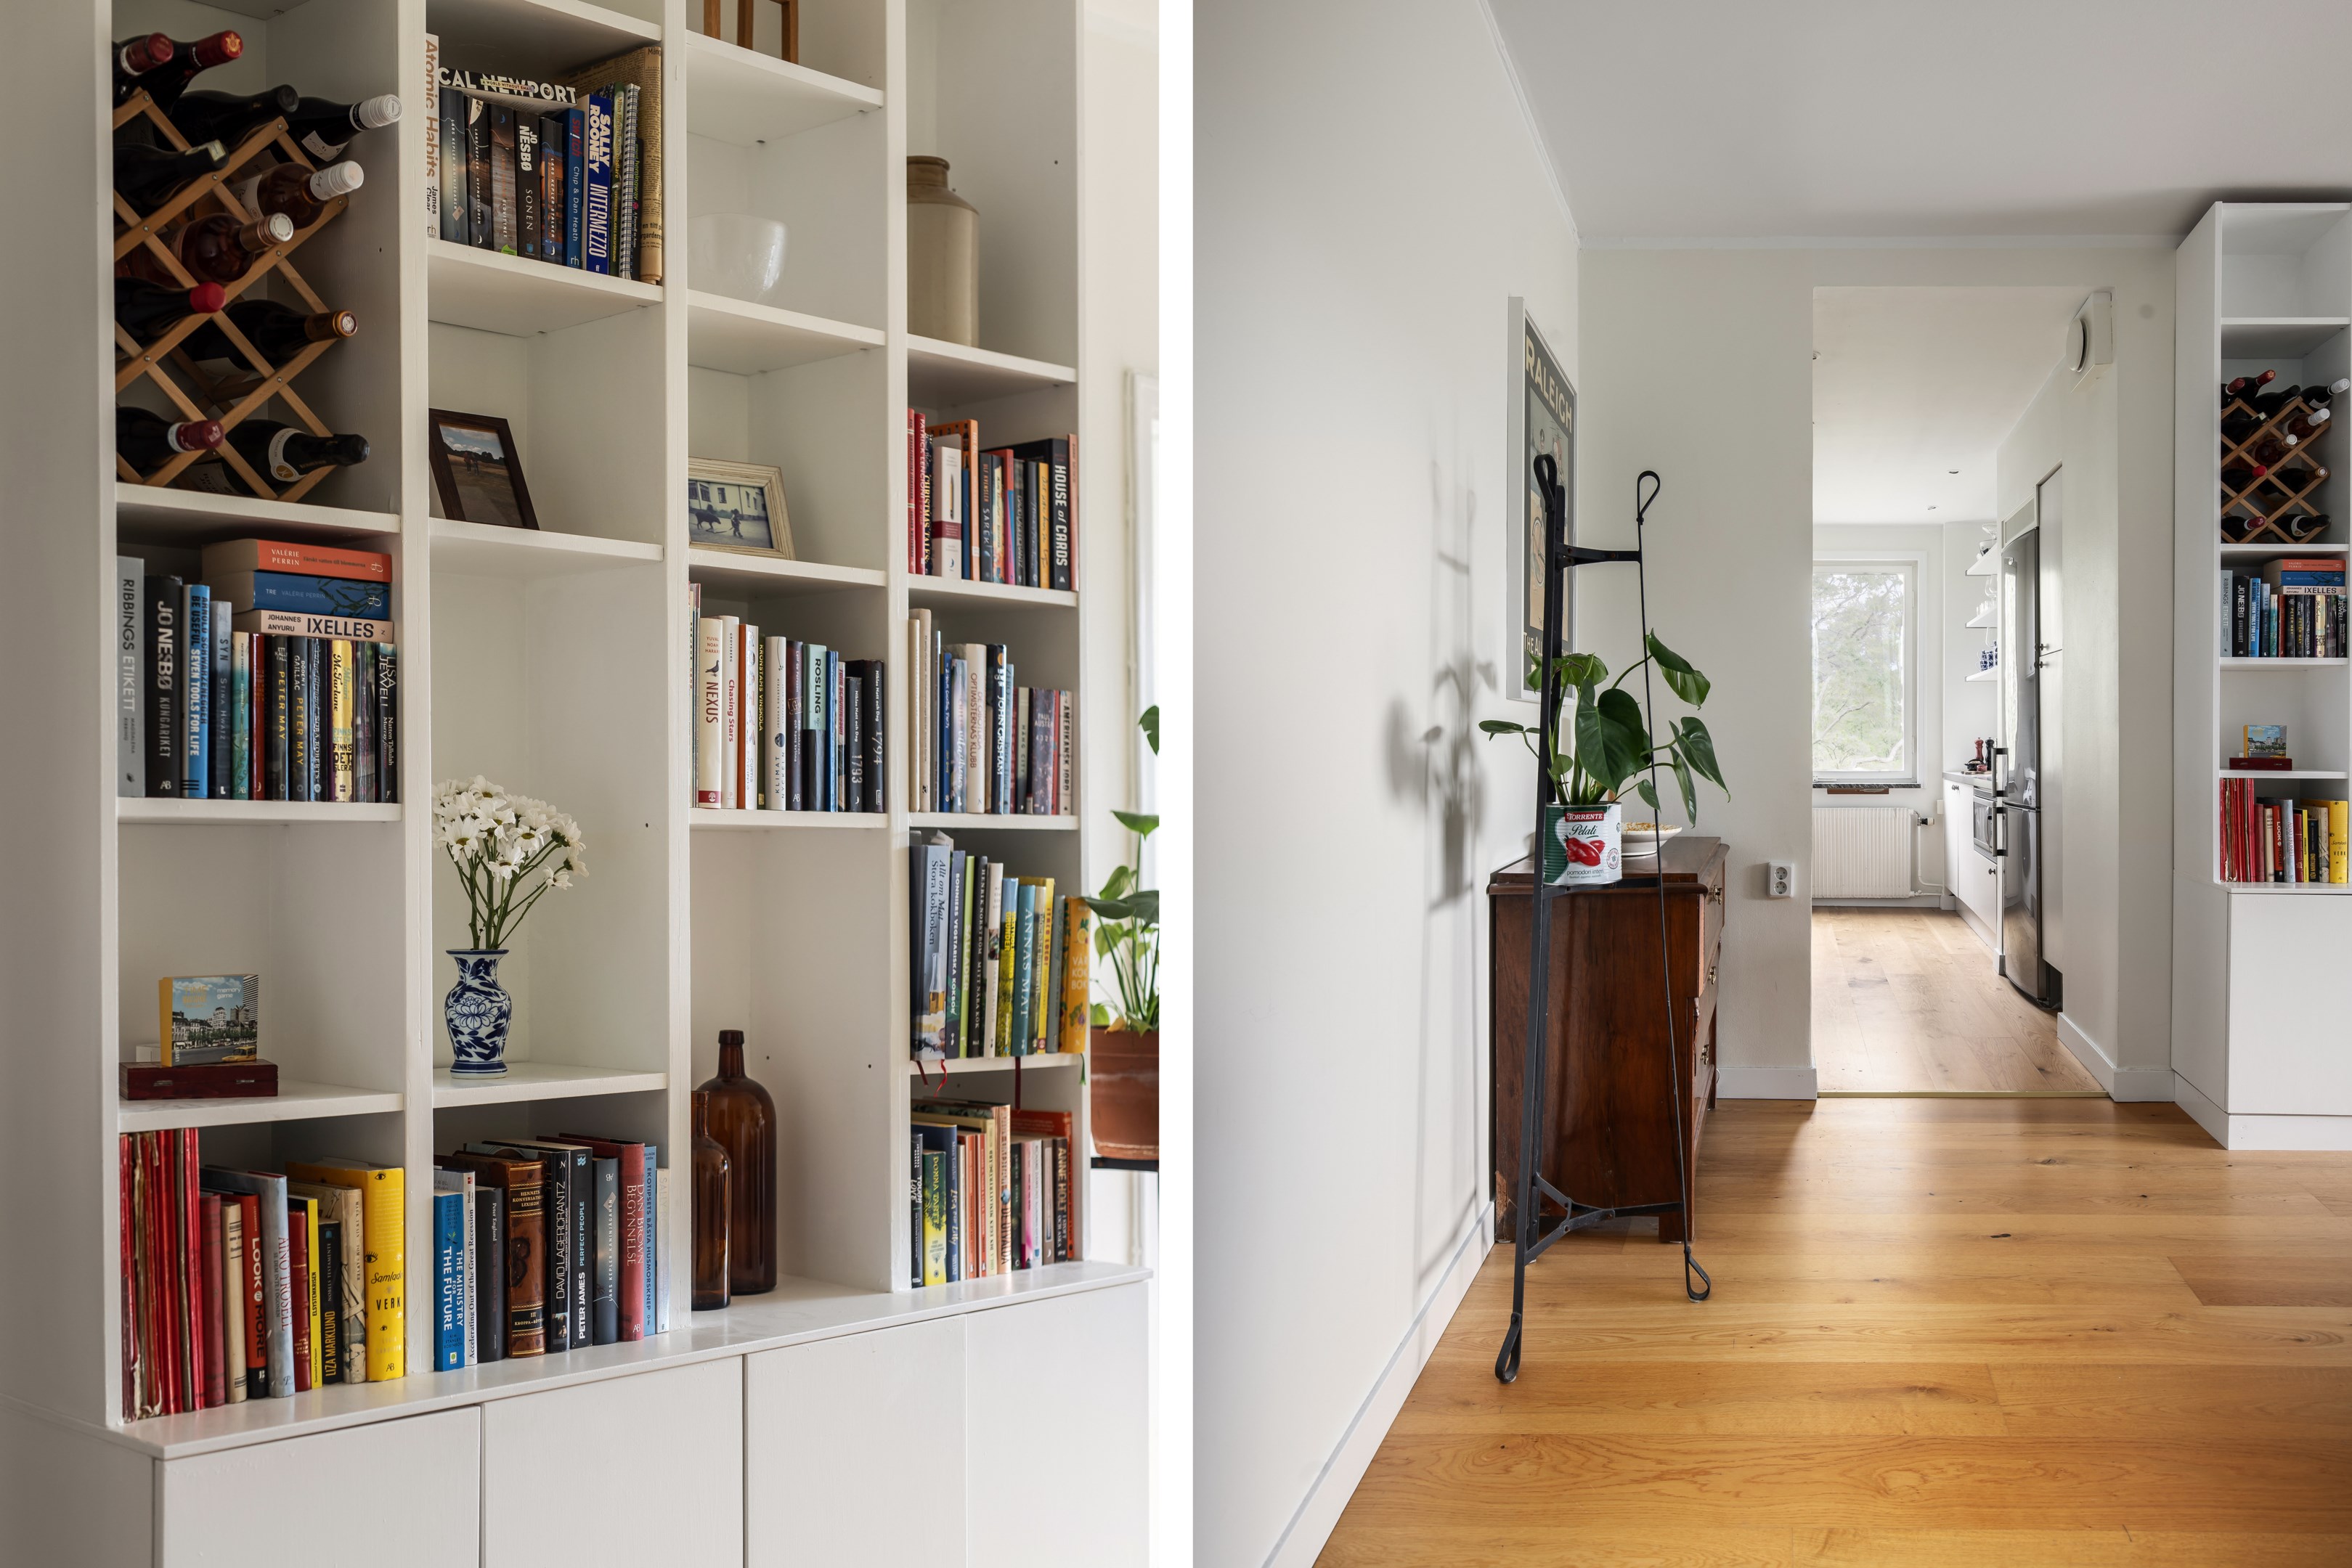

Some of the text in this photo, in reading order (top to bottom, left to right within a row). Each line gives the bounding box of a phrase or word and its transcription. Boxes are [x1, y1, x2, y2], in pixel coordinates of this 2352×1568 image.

[426, 39, 439, 178] Atomic Habits
[439, 67, 577, 104] CAL NEWPORT
[519, 126, 532, 171] NESBØ
[529, 132, 538, 144] JO
[589, 105, 600, 173] ROONEY
[599, 114, 611, 168] SALLY
[525, 189, 534, 230] SONEN
[589, 184, 609, 258] INTERMEZZO
[1526, 335, 1571, 433] RALEIGH
[1054, 465, 1068, 566] HOUSE of CARDS
[271, 548, 300, 557] VALÉRIE
[272, 558, 300, 566] PERRIN
[2237, 585, 2245, 594] JO
[268, 614, 301, 623] JOHANNES
[307, 618, 374, 639] IXELLES
[1523, 632, 1534, 654] THE
[122, 579, 135, 712] RIBBINGS ETIKETT
[220, 639, 229, 661] SYN
[158, 601, 174, 758] JO NESBØ KUNGARIKET
[190, 595, 200, 756] BE USEFUL SEVEN TOOLS FOR LIFE
[333, 653, 343, 711] McFarlane
[706, 682, 719, 723] NEXUS
[851, 754, 863, 784] 1793
[871, 730, 883, 765] 1794
[1569, 824, 1598, 836] Pelati
[937, 881, 943, 895] om
[929, 892, 938, 944] kokboken
[1020, 909, 1033, 1018] ANNAS MAT
[1058, 1147, 1067, 1212] ANNE HOLT
[556, 1182, 566, 1299] DAVID LAGERCRANTZ
[627, 1185, 637, 1266] BEGYNNELSE
[252, 1237, 265, 1357] LOOK MORE
[376, 1297, 401, 1310] VERK
[443, 1246, 452, 1331] THE FUTURE
[325, 1311, 337, 1376] LIZA MARKLUND
